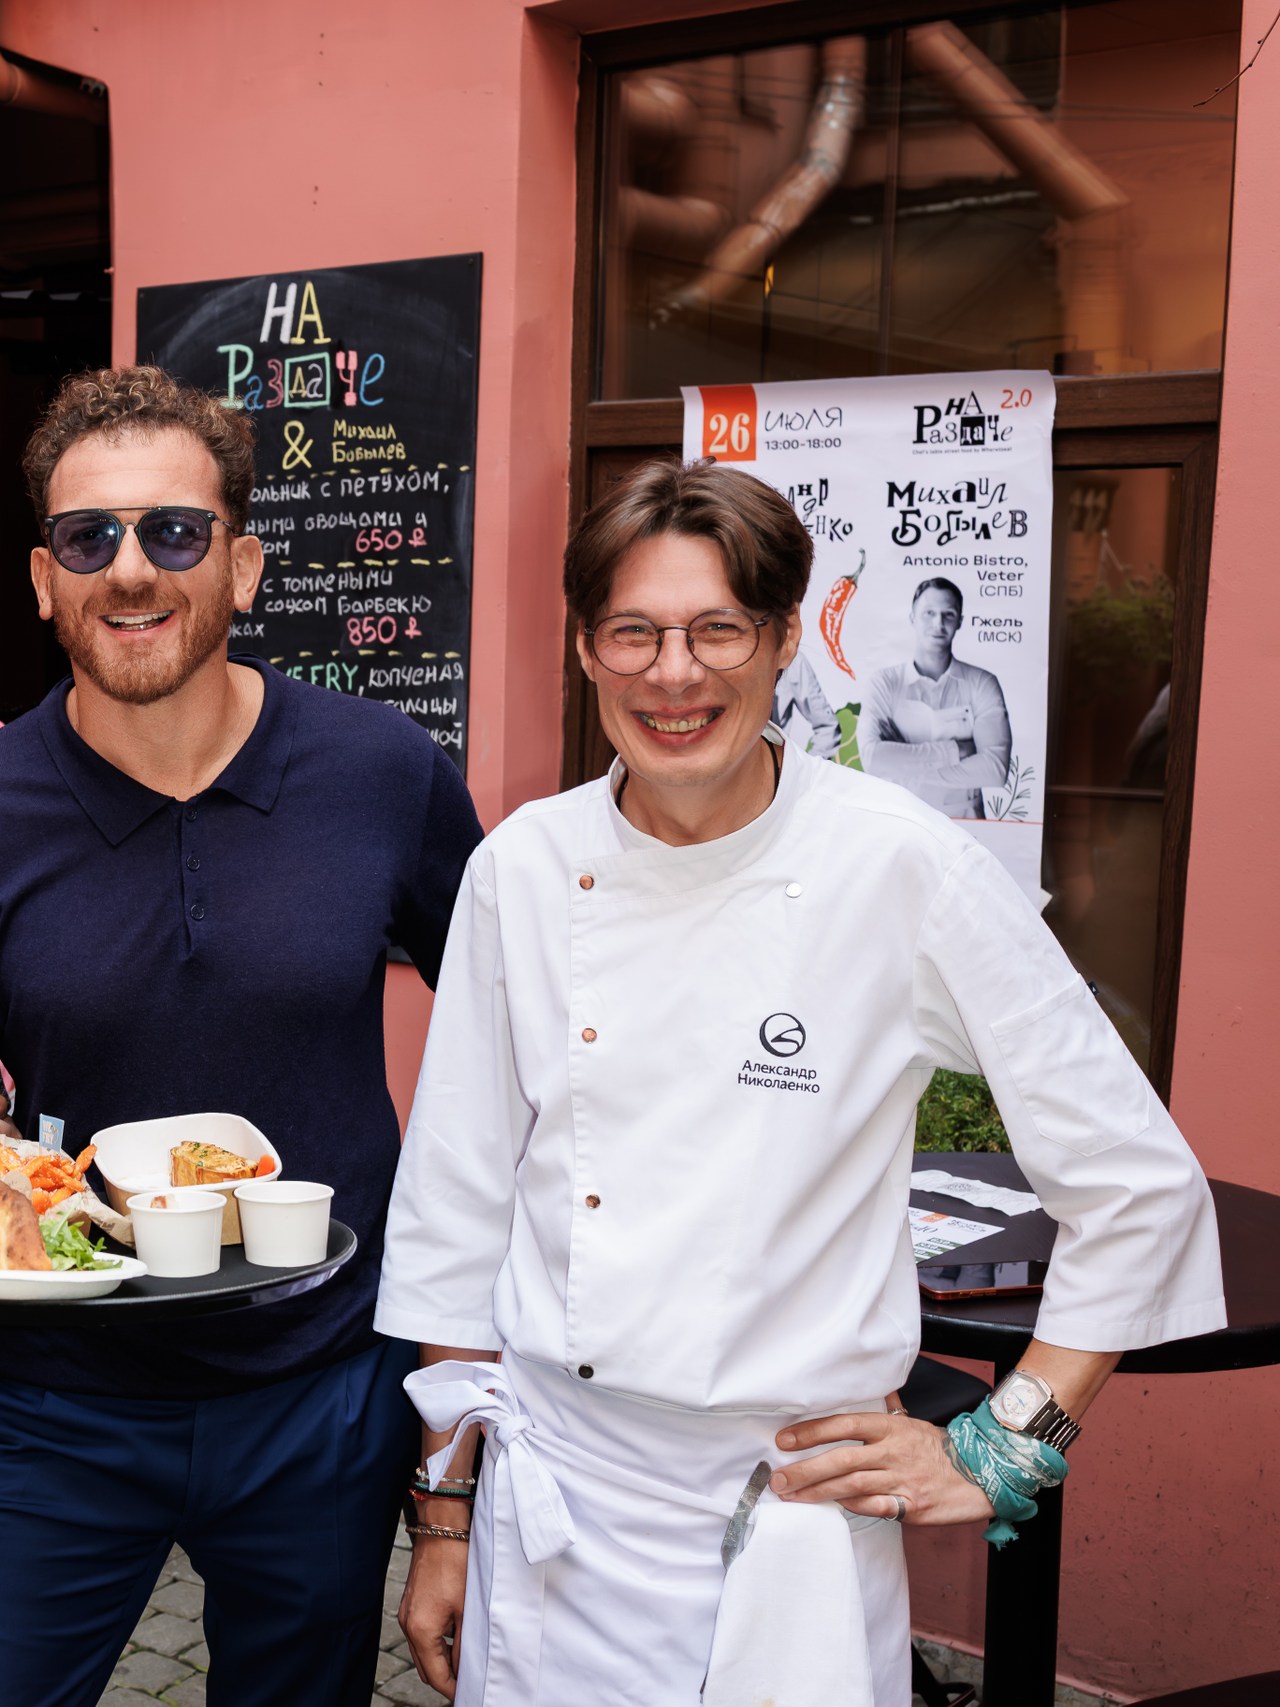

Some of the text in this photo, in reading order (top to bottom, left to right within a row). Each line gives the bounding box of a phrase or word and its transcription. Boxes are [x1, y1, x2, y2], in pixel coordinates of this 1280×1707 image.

[259, 280, 332, 345] НА
[1000, 389, 1032, 409] 2.0
[333, 419, 397, 440] Михаил
[708, 412, 750, 453] 26
[282, 420, 314, 470] &
[765, 437, 842, 451] 13:00-18:00
[250, 481, 311, 502] ольник
[320, 482, 331, 498] с
[245, 517, 295, 535] ными
[355, 528, 403, 553] 650
[903, 554, 1028, 568] Antonio Bistro,
[262, 578, 274, 593] с
[977, 570, 1025, 582] Veter
[979, 584, 1023, 598] (СПБ)
[347, 615, 397, 646] 850
[971, 616, 1023, 628] Гжель
[977, 630, 1022, 644] (МСК)
[742, 1059, 817, 1080] Александр
[737, 1073, 820, 1094] Николаенко
